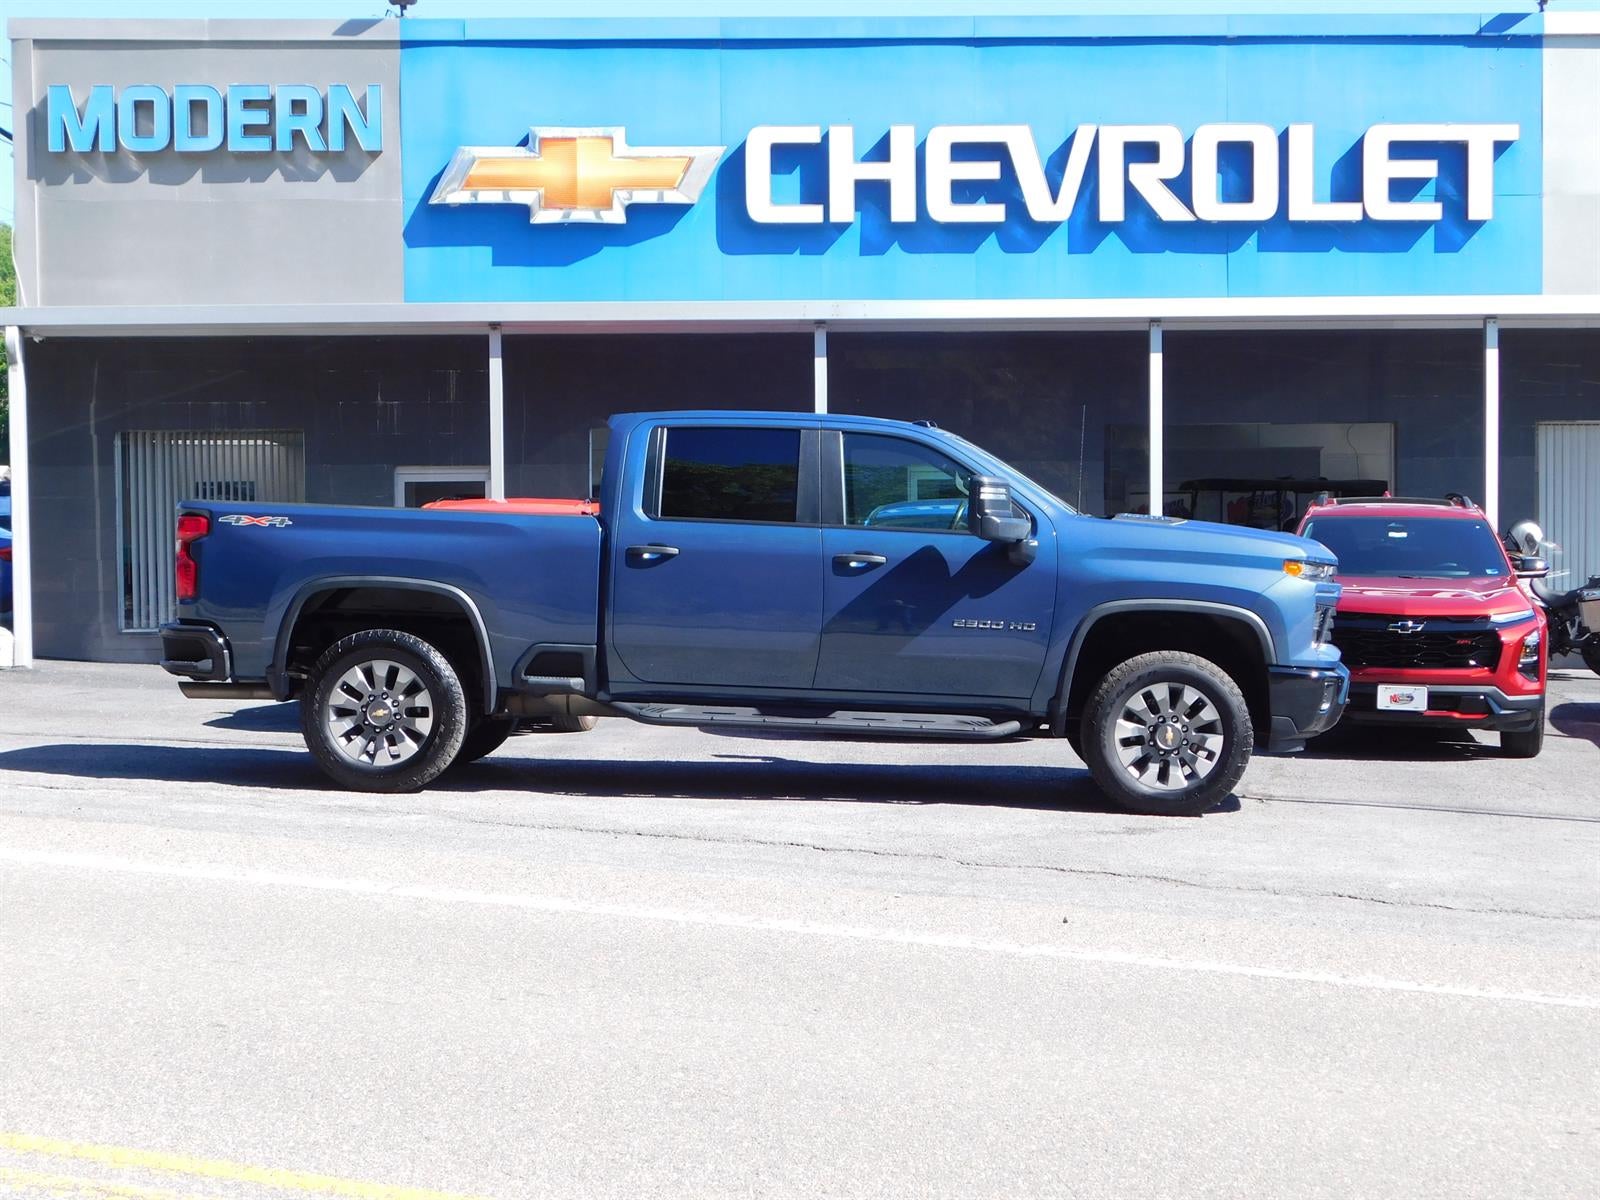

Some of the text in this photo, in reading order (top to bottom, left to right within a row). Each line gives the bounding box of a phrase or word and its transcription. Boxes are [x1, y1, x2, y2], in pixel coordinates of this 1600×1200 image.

[47, 83, 383, 154] MODERN
[744, 122, 1521, 225] CHEVROLET
[1009, 621, 1036, 631] HD
